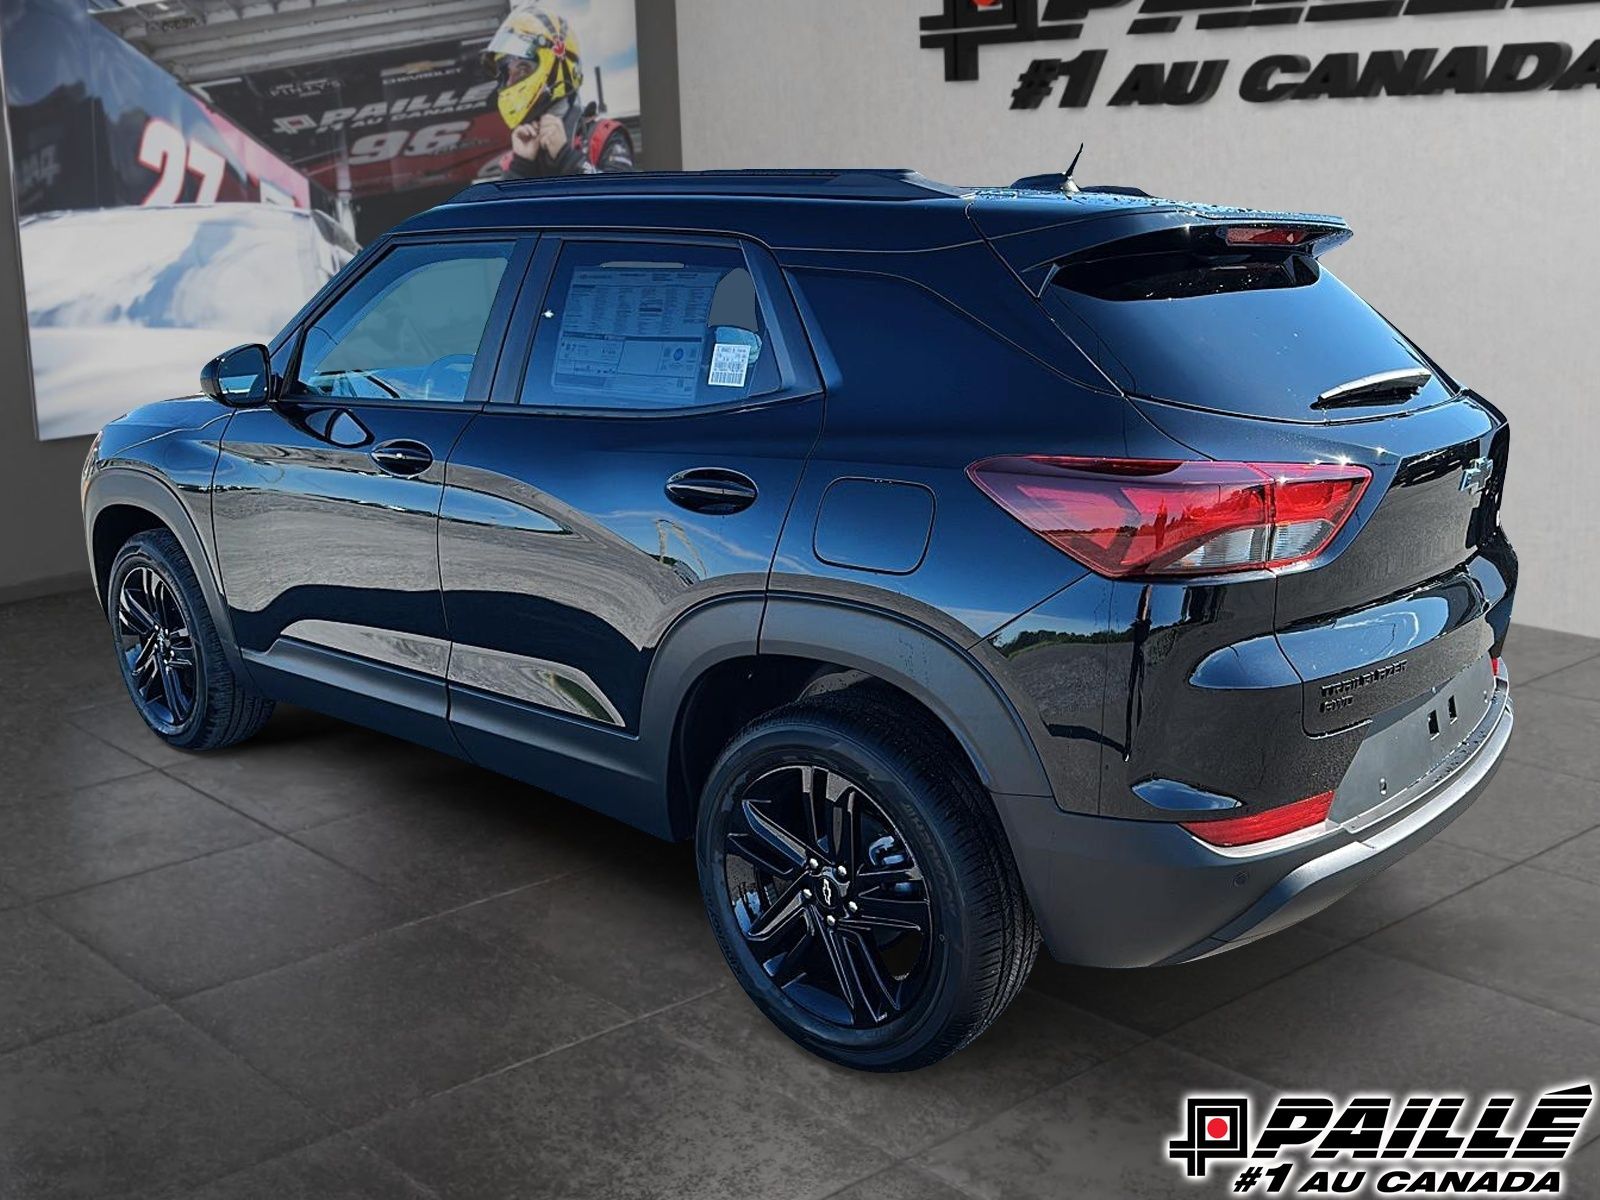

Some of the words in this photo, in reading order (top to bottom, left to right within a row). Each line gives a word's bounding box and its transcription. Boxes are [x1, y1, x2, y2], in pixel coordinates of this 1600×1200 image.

[1009, 49, 1109, 110] #1
[1106, 60, 1230, 107] AU
[1239, 40, 1600, 102] CANADA
[390, 101, 488, 121] CANADA
[138, 118, 227, 206] 27
[349, 121, 471, 166] 96
